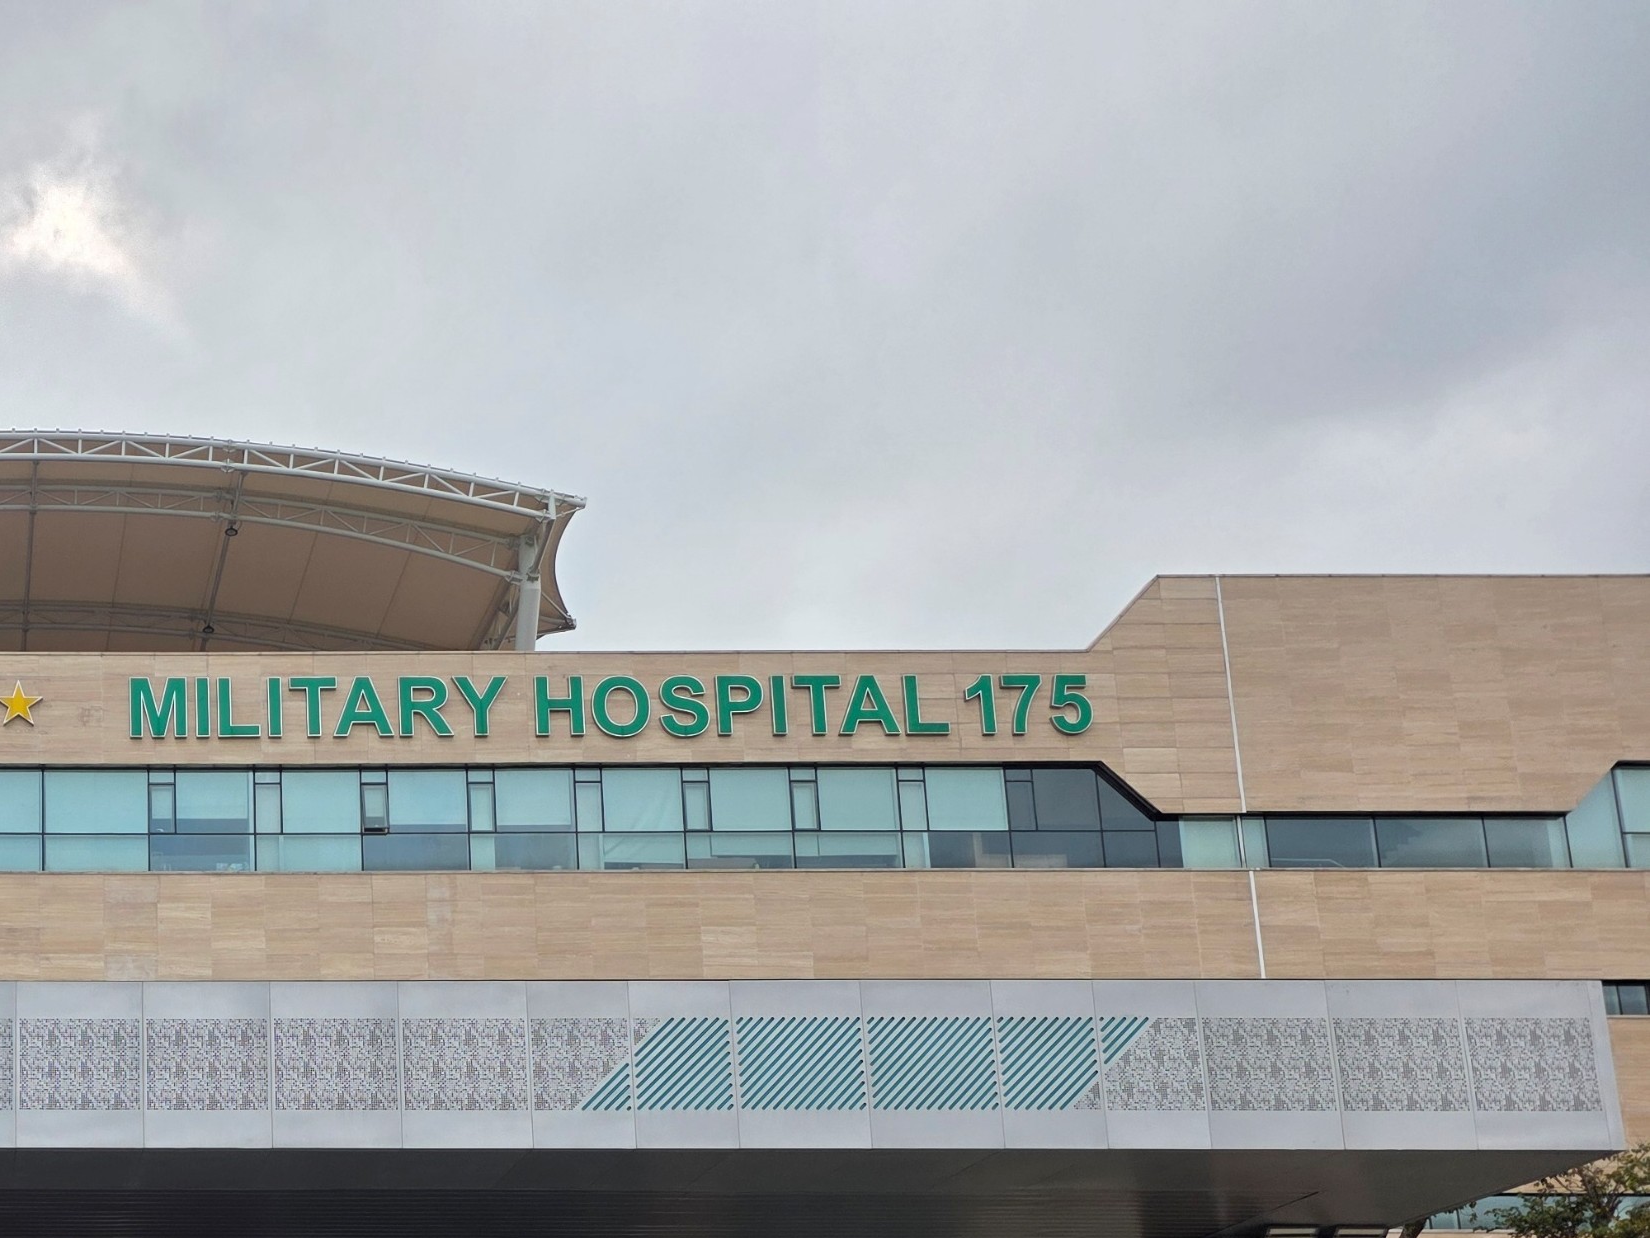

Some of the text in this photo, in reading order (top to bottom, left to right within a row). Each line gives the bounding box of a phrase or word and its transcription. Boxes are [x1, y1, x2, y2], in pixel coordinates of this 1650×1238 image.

[128, 673, 1094, 738] MILITARY HOSPITAL 175
